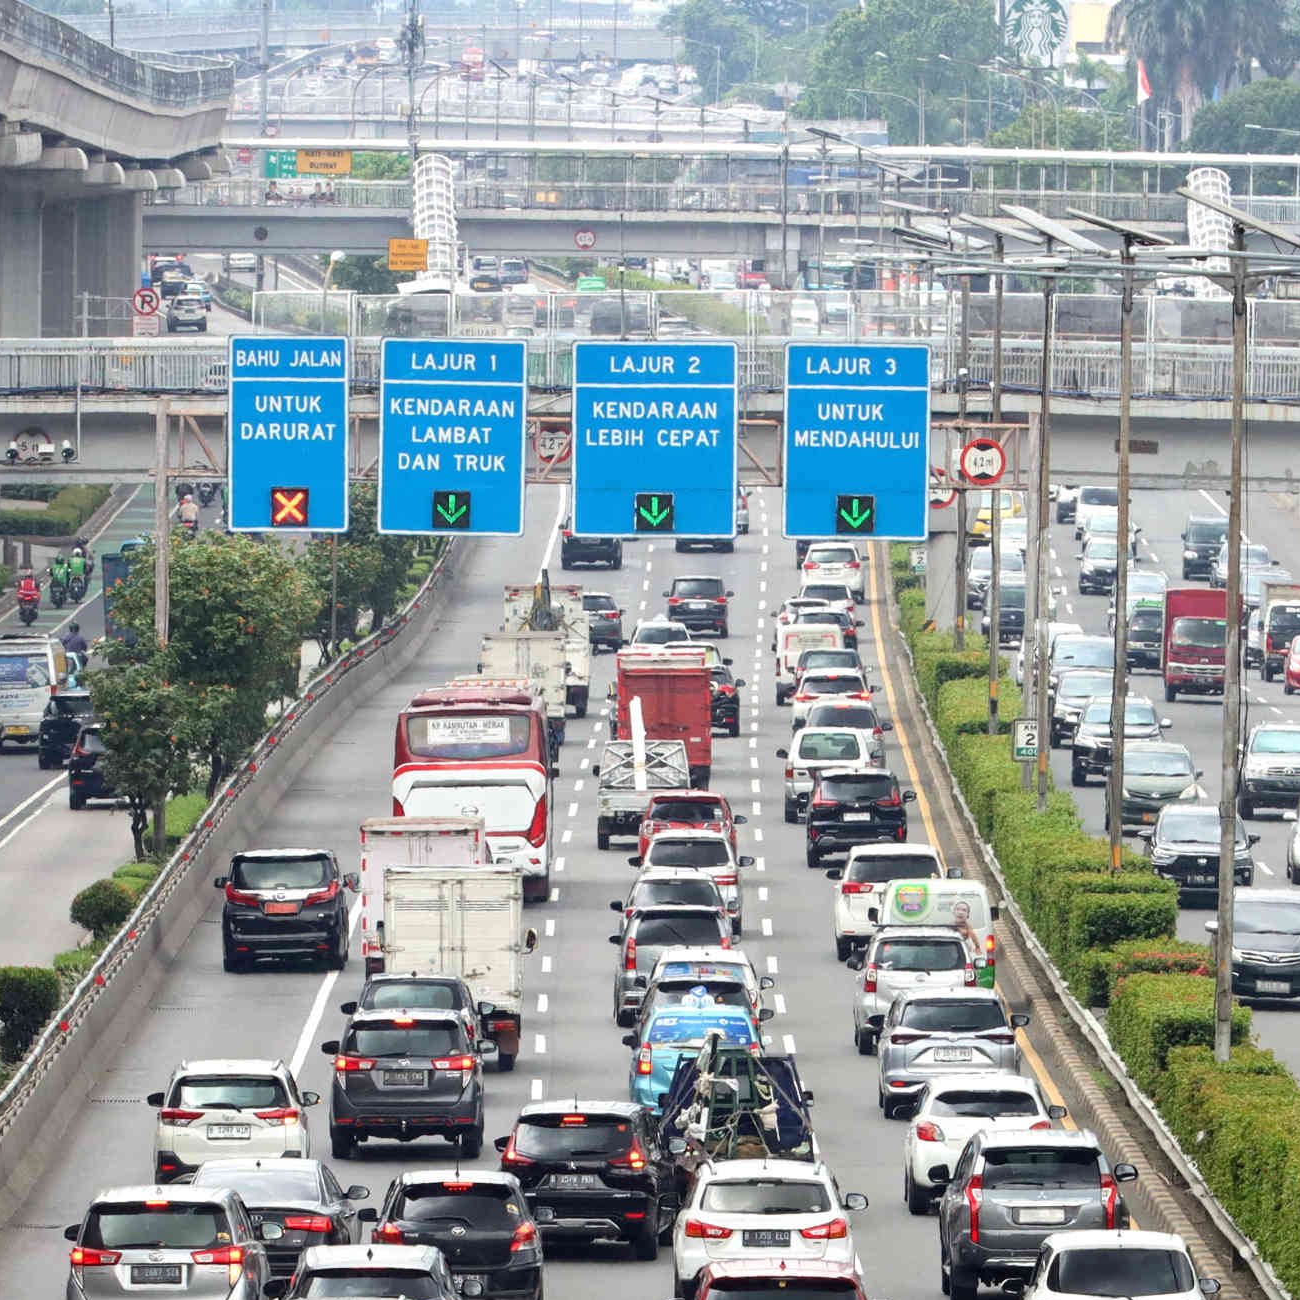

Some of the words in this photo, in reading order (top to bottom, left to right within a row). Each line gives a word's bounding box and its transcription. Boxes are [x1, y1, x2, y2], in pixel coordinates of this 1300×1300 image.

[236, 351, 282, 368] BAHU
[289, 350, 342, 367] JALAN
[411, 353, 476, 371] LAJUR
[490, 354, 496, 371] 1
[610, 355, 675, 374] LAJUR
[688, 356, 701, 374] 2
[806, 357, 871, 375] LAJUR
[884, 357, 897, 375] 3
[255, 395, 321, 413] UNTUK
[390, 397, 515, 417] KENDARAAN
[593, 401, 718, 419] KENDARAAN
[818, 403, 884, 421] UNTUK
[240, 422, 336, 441] DARURAT
[411, 426, 492, 444] LAMBAT
[586, 428, 644, 446] LEBIH
[657, 429, 720, 447] CEPAT
[794, 430, 919, 449] MENDAHULUI
[398, 452, 440, 471] DAN
[453, 454, 505, 472] TRUK
[1025, 733, 1036, 746] 2
